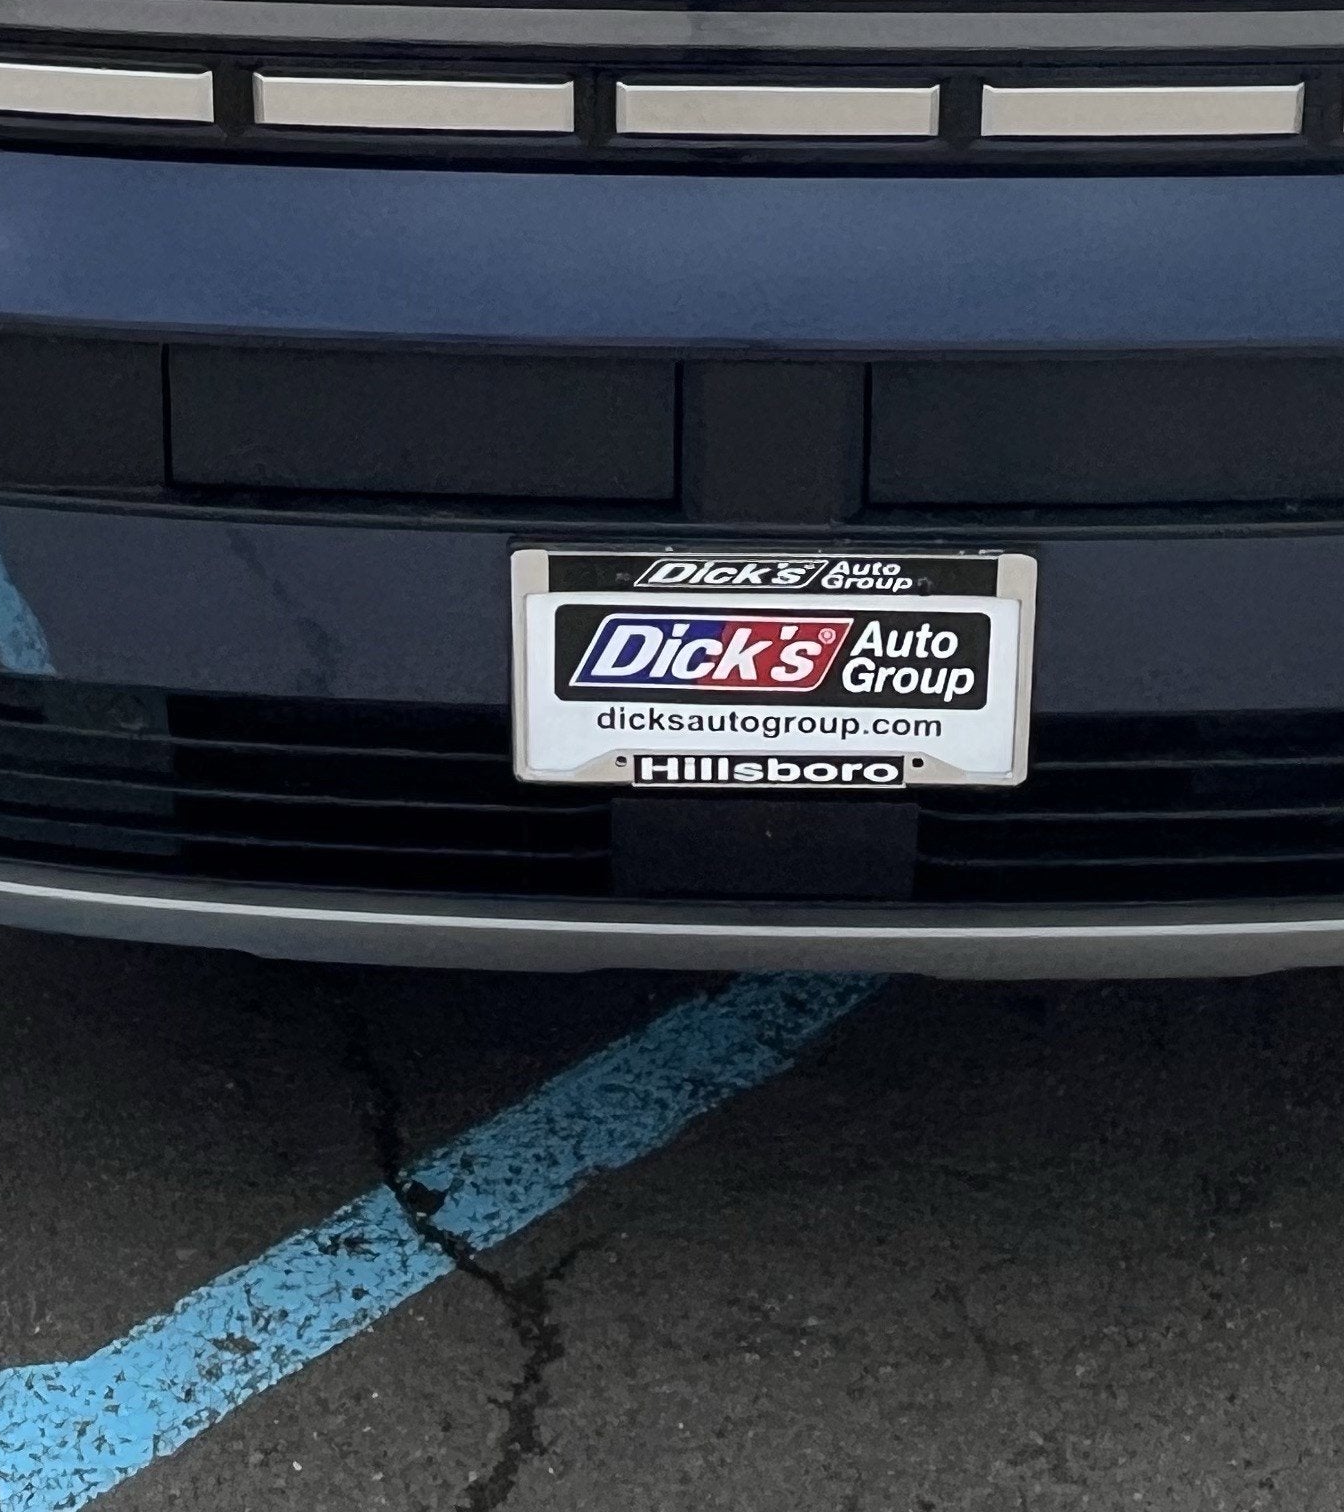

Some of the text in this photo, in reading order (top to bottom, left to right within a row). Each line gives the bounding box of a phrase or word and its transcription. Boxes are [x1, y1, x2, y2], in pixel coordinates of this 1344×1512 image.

[648, 560, 808, 587] Dick's
[829, 560, 903, 576] Auto
[821, 574, 914, 593] Group
[590, 622, 825, 682] Dick's
[849, 621, 959, 660] Auto
[841, 659, 975, 701] Group
[597, 706, 942, 739] dicksautogroup.com
[639, 755, 900, 783] Hillsboro
